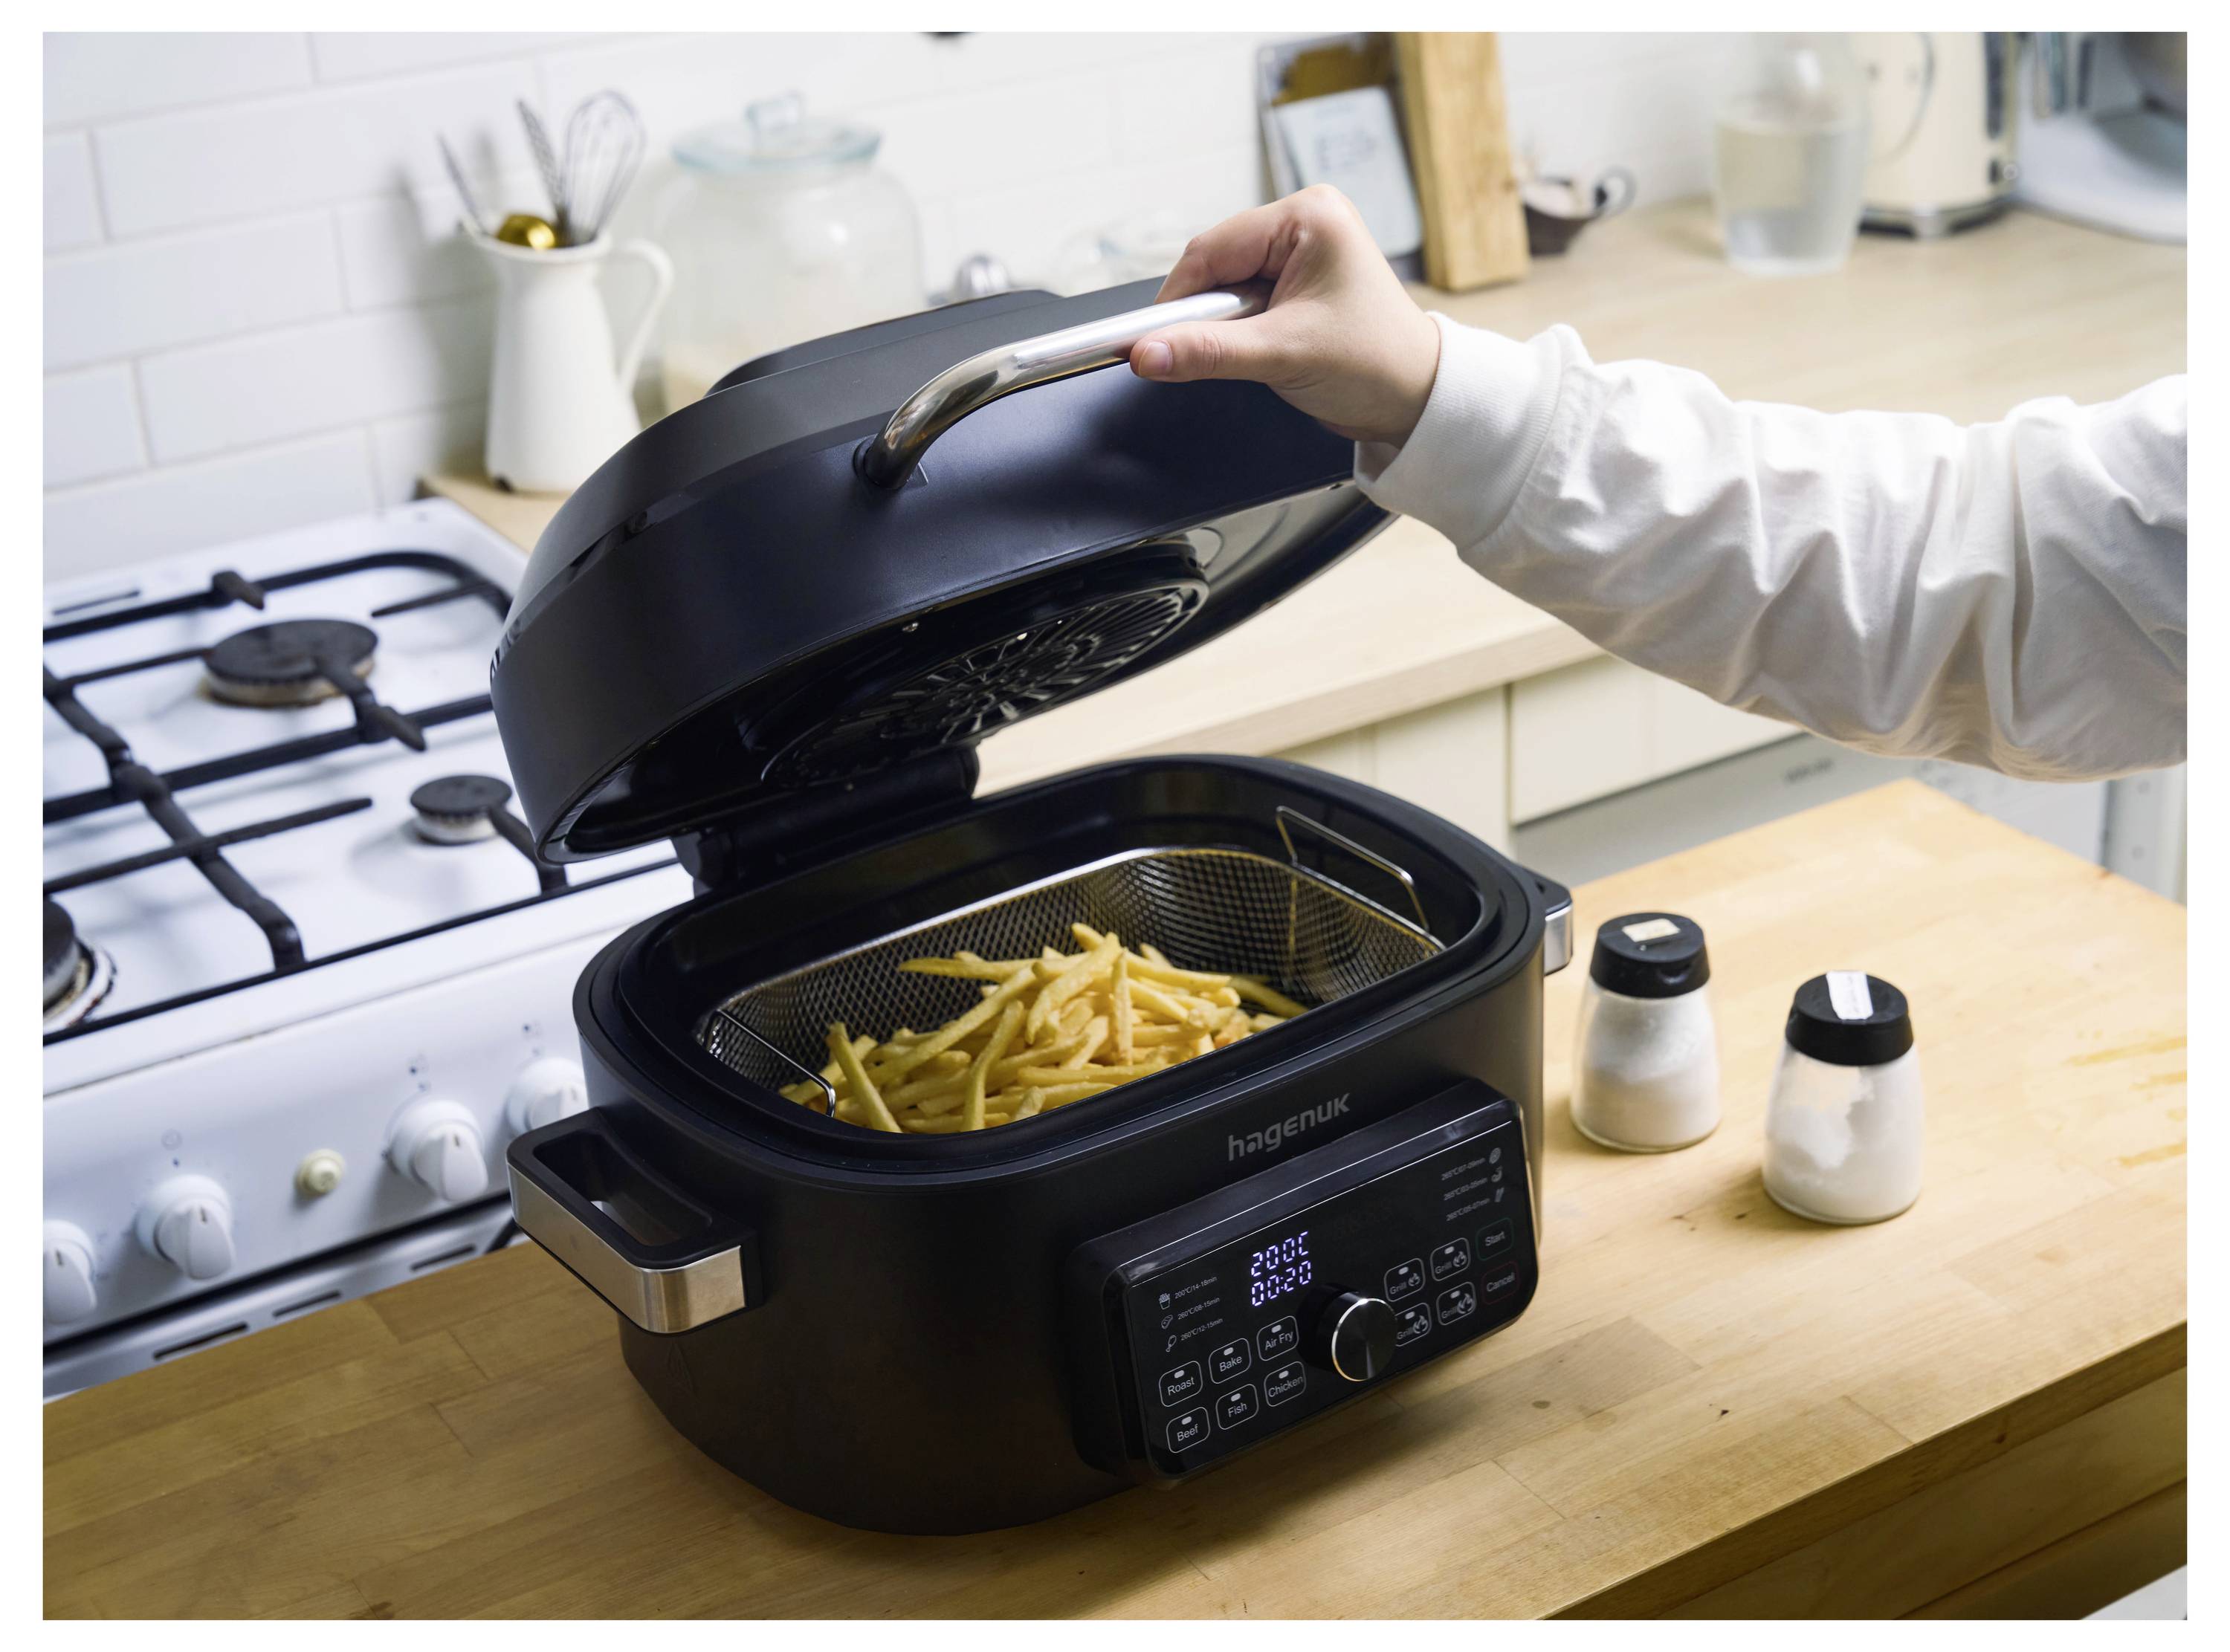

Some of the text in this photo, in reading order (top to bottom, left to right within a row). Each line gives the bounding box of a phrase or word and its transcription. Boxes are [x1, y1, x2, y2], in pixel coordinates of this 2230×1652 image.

[1228, 1092, 1351, 1162] hagenuk
[1485, 1231, 1505, 1246] Start
[1435, 1261, 1452, 1274] Grill
[1252, 1260, 1311, 1306] 00:20
[1389, 1282, 1407, 1295] Grill
[1487, 1272, 1515, 1292] Cancel
[1264, 1331, 1293, 1351] Air Fry
[1219, 1356, 1243, 1372] Bake
[1167, 1376, 1195, 1396] Roast
[1268, 1376, 1303, 1398] Chicken
[1227, 1402, 1247, 1418] Fish
[1177, 1424, 1199, 1442] Beef
